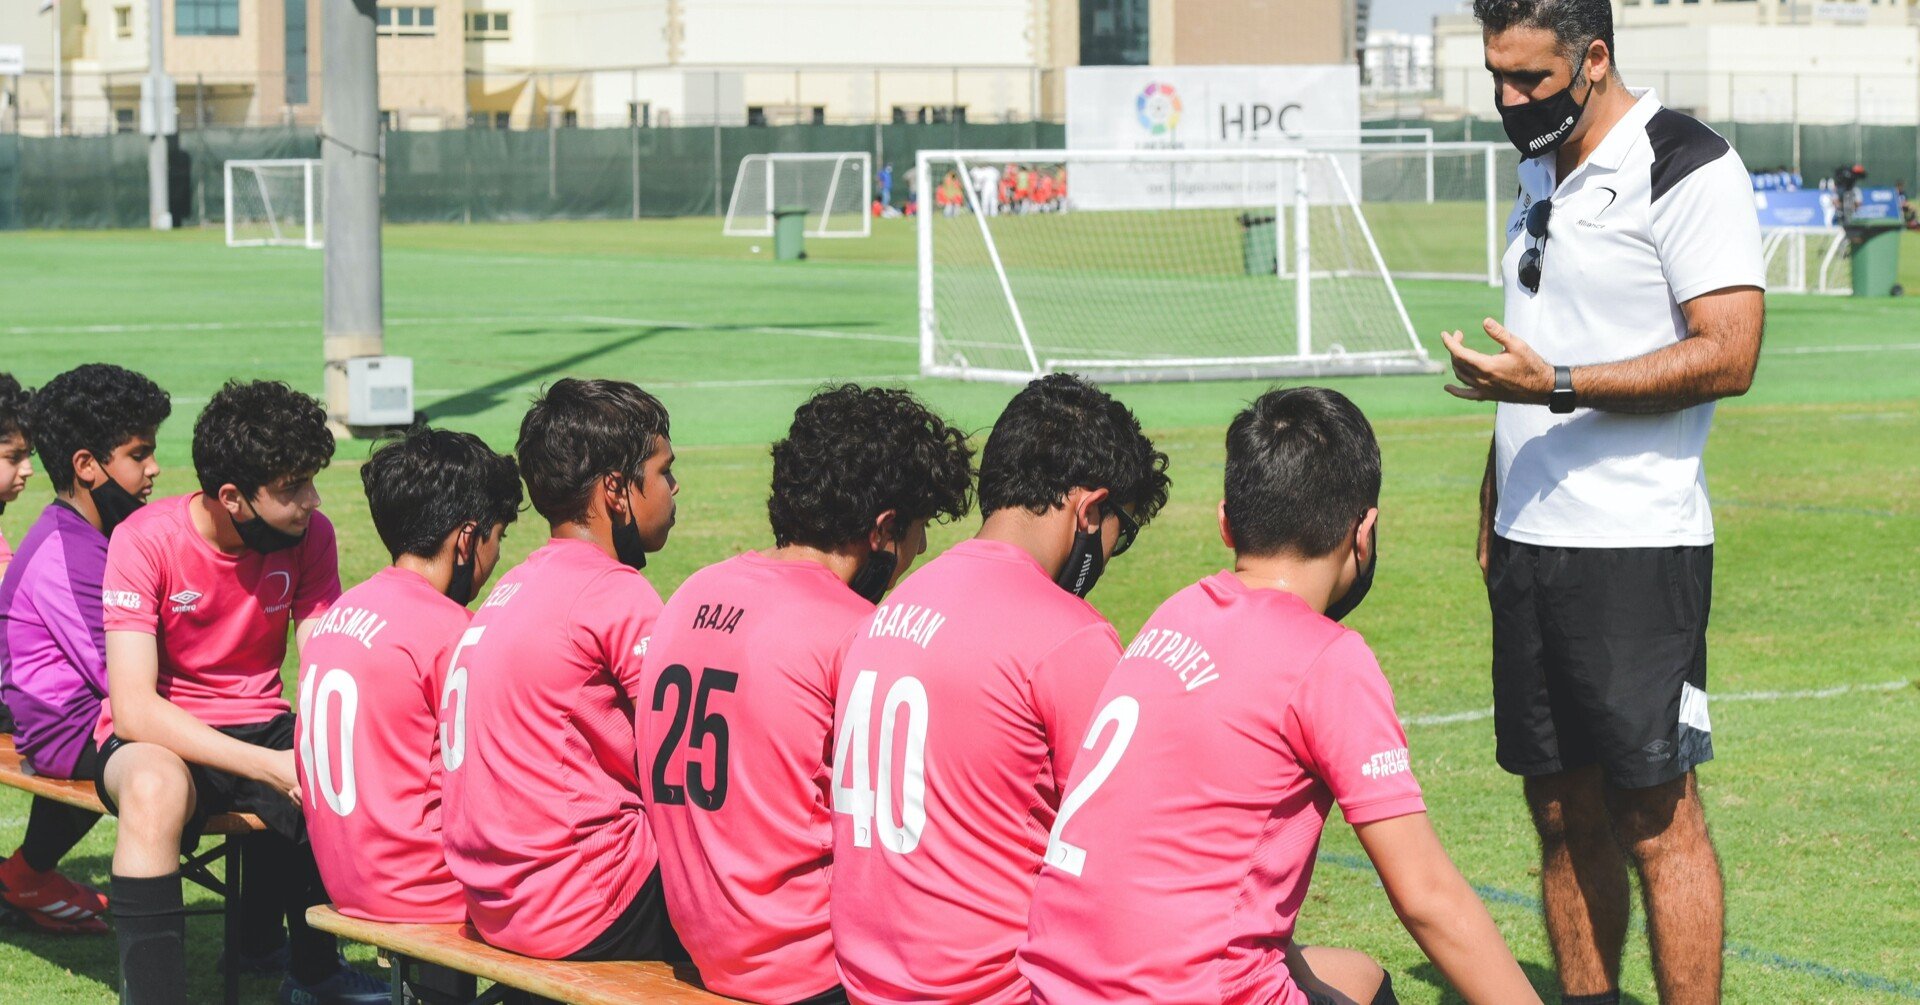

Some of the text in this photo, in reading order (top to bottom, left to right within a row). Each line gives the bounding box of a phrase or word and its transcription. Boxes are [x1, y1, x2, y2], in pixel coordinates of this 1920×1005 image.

[1221, 103, 1302, 140] HPC
[1528, 115, 1575, 152] Alliance
[692, 604, 745, 634] RAJA
[868, 603, 947, 650] RAKAN
[1119, 628, 1220, 692] ORTPAYEV
[300, 663, 359, 817] 10
[440, 625, 487, 772] 5
[651, 663, 739, 812] 25
[832, 670, 929, 855] 40
[1043, 694, 1140, 878] 2
